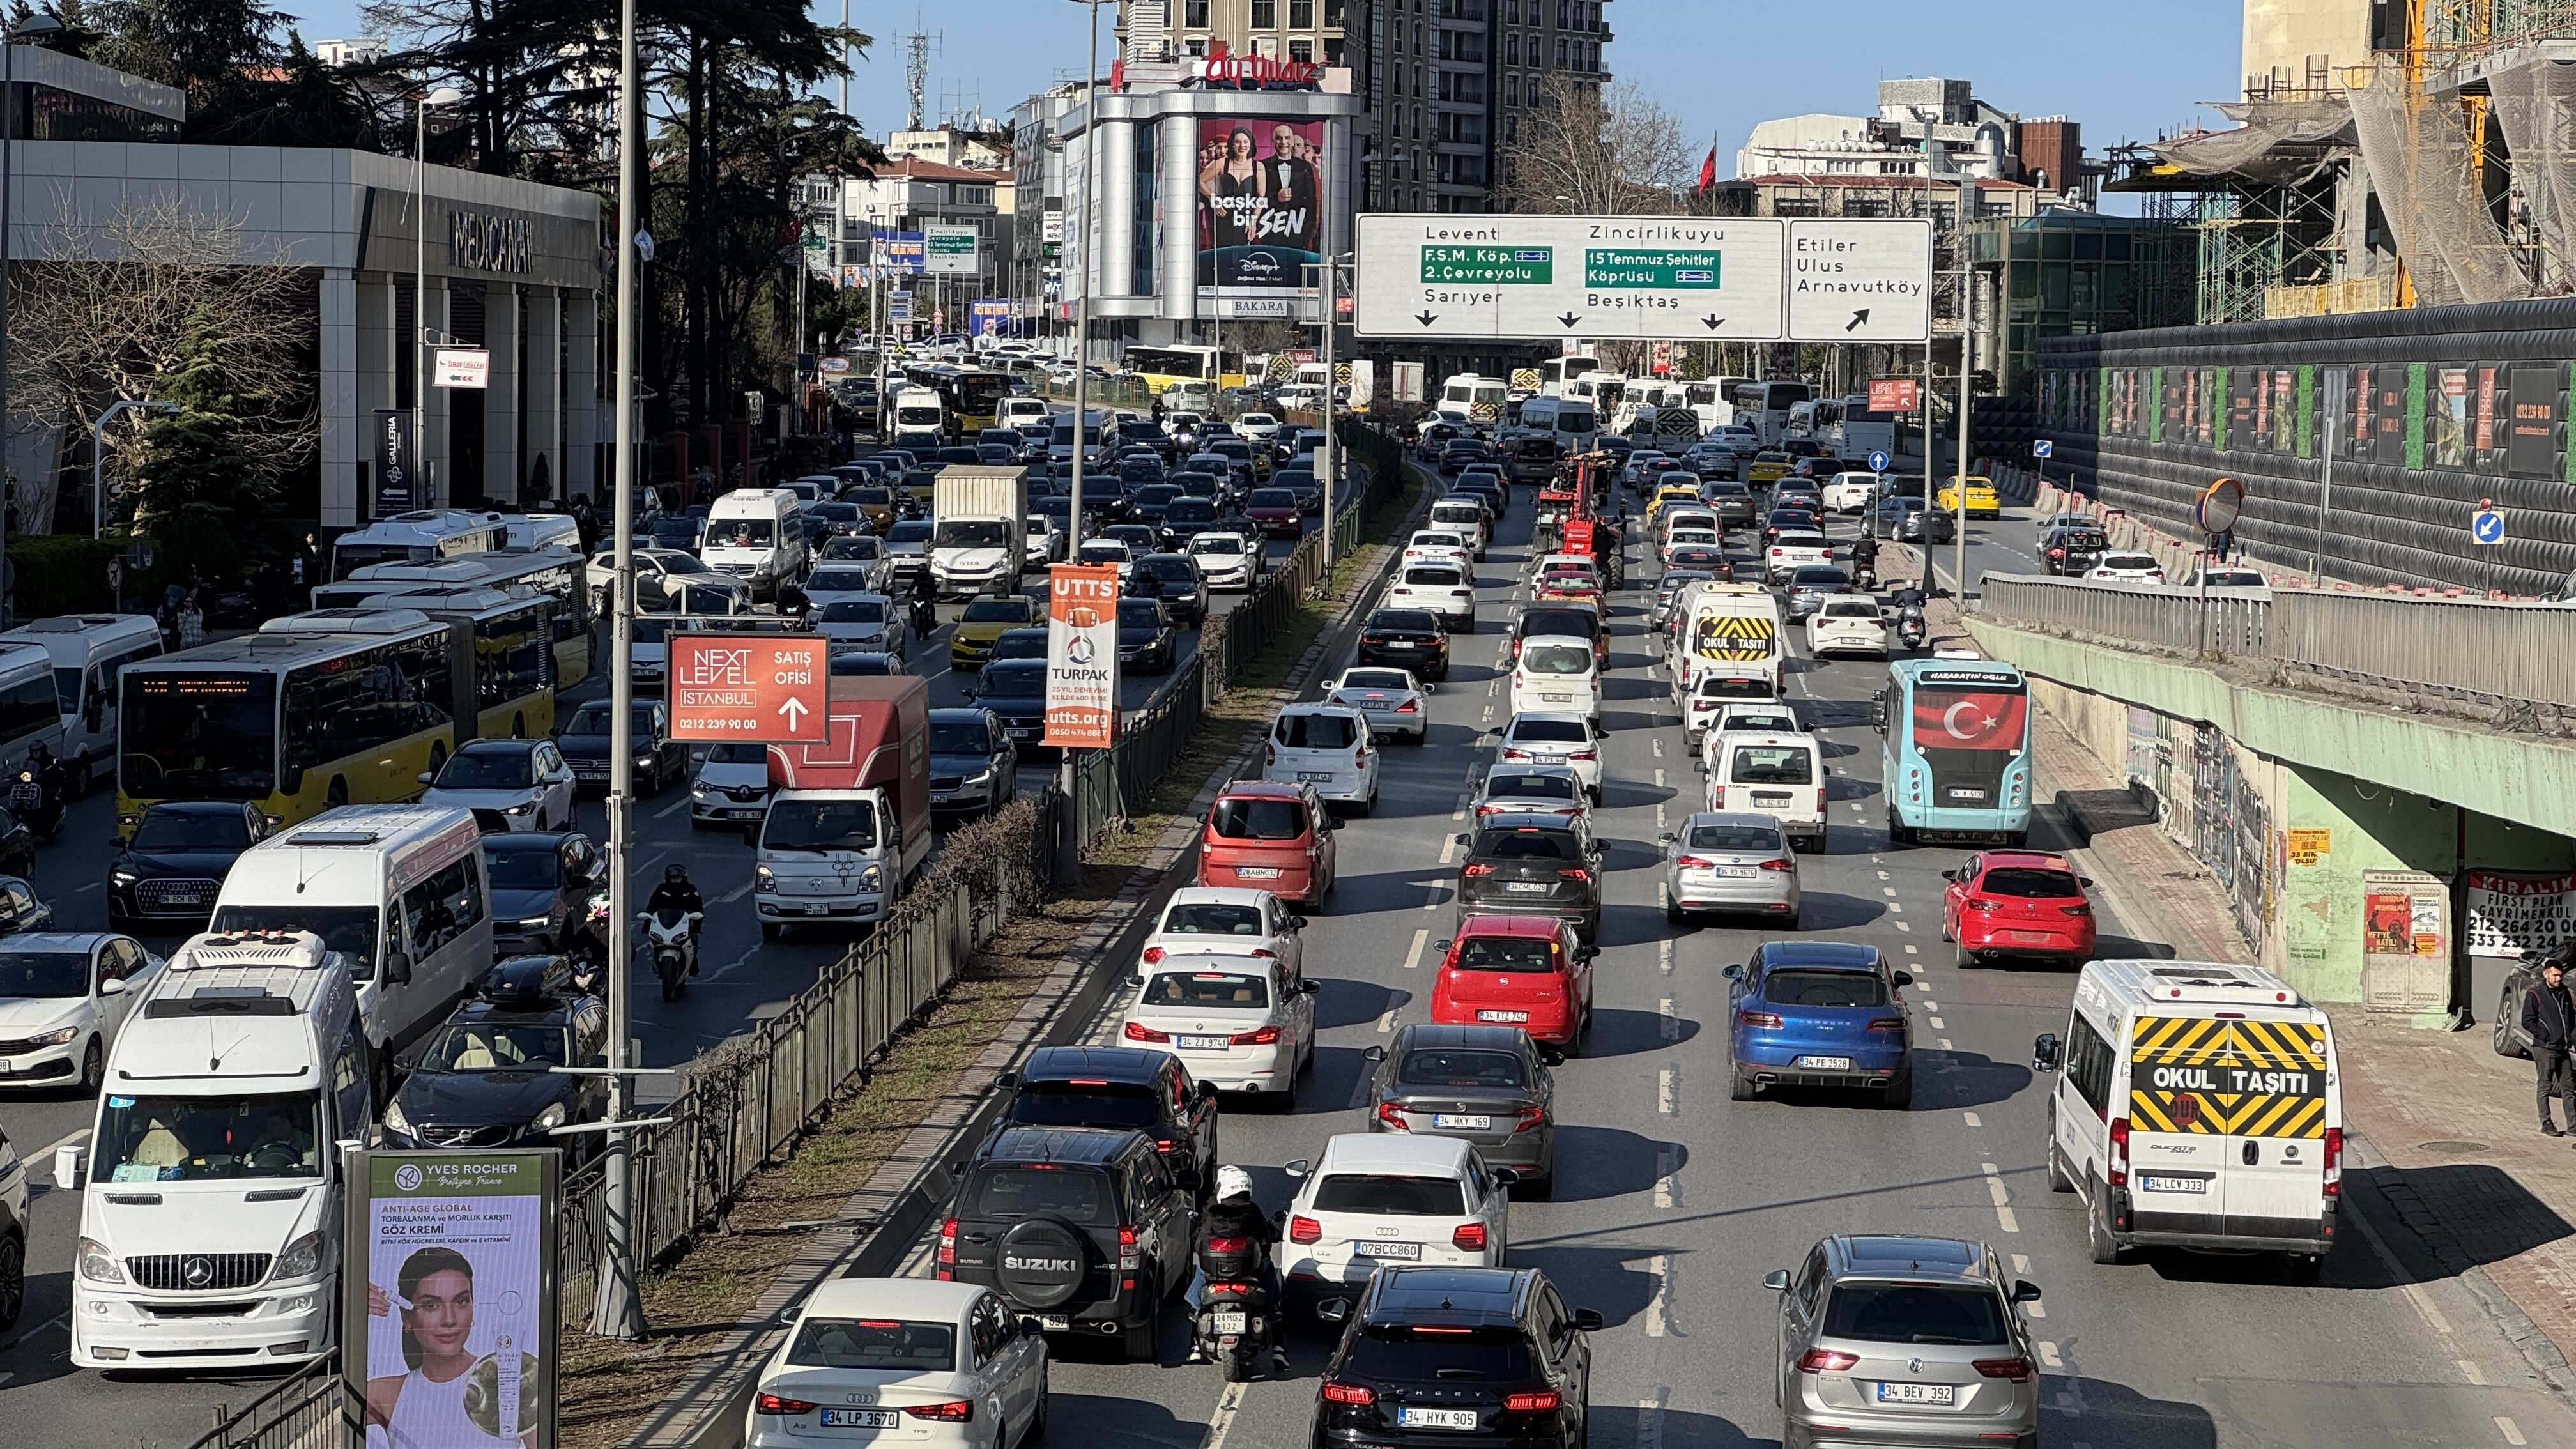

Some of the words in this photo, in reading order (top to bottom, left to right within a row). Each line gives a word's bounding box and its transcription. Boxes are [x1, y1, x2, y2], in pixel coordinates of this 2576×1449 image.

[1211, 192, 1268, 211] başka
[1234, 210, 1258, 226] bir
[1255, 208, 1306, 238] SEN
[1426, 226, 1497, 240] Levent
[1590, 226, 1724, 243] Zincirlikuyu
[1798, 238, 1857, 251] Etiler
[1425, 249, 1470, 261] F.S.M.
[1477, 250, 1511, 264] Köp.
[1589, 253, 1605, 264] 15
[1607, 253, 1664, 266] Temmuz
[1666, 254, 1715, 266] Şehitler
[1797, 259, 1843, 272] Ulus
[1425, 266, 1531, 281] 2.Çevreyolu
[1588, 270, 1655, 285] Köprüsü
[1797, 279, 1922, 296] Arnavutköy
[1424, 289, 1503, 306] Sarıyer
[1588, 294, 1679, 309] Beşiktaş
[1235, 301, 1284, 311] BAKARA
[388, 416, 397, 464] GALLERIA
[1055, 578, 1113, 597] UTTS
[1704, 638, 1729, 648] OKUL
[1738, 639, 1765, 650] TAŞITI
[694, 650, 752, 666] NEXT
[774, 652, 812, 668] SATIŞ
[680, 667, 757, 684] LEVEL
[774, 669, 811, 685] OFİSİ
[1052, 668, 1108, 681] TURPAK
[1931, 672, 1981, 680] HARABATIN
[683, 691, 754, 705] İSTANBUL
[680, 719, 705, 729] 0212
[707, 719, 726, 730] 239
[728, 719, 741, 730] 90
[743, 719, 756, 730] 00
[1049, 710, 1108, 728] utts.org
[1050, 728, 1070, 736] 0850
[2483, 875, 2572, 894] KİRALIK
[2533, 895, 2563, 908] PLAN
[2479, 905, 2571, 920] GAYRİMENKUL
[2468, 917, 2494, 931] 212
[2499, 919, 2529, 933] 264
[2534, 919, 2555, 933] 20
[2467, 933, 2496, 947] 533
[2502, 935, 2531, 949] 232
[2537, 935, 2557, 949] 24
[1195, 1038, 1205, 1046] ZJ
[1208, 1039, 1226, 1047] 9741
[1804, 1057, 1814, 1066] 34
[1816, 1058, 1826, 1066] PE
[1828, 1059, 1847, 1068] 2528
[2154, 1068, 2216, 1090] OKUL
[2232, 1070, 2308, 1097] TAŞITI
[2170, 1101, 2200, 1118] DUR
[1439, 1117, 1449, 1125] 34
[1454, 1117, 1469, 1126] HKY
[1474, 1118, 1487, 1126] 169
[427, 1165, 458, 1174] YVES
[463, 1164, 518, 1174] ROCHER
[2150, 1178, 2161, 1188] 34
[2165, 1179, 2182, 1189] LCV
[2184, 1180, 2202, 1190] 333
[382, 1205, 429, 1213] ANTI-AGE
[432, 1204, 473, 1213] GLOBAL
[381, 1215, 436, 1223] TORBALANMA
[448, 1214, 482, 1222] MORLUK
[484, 1213, 512, 1223] KARŞITI
[381, 1223, 406, 1236] GÖZ
[409, 1222, 445, 1234] KREMİ
[1361, 1243, 1416, 1255] 07BCC860
[1004, 1257, 1077, 1272] SUZUKI
[1396, 1388, 1482, 1397] CHERY
[1885, 1384, 1897, 1397] 34
[1905, 1386, 1924, 1398] BEV
[1931, 1387, 1950, 1399] 392
[828, 1411, 842, 1424] 34
[848, 1412, 862, 1425] LP
[867, 1413, 895, 1426] 3670
[1407, 1410, 1420, 1423] 34
[1427, 1411, 1447, 1425] HYK
[1453, 1413, 1473, 1426] 905
